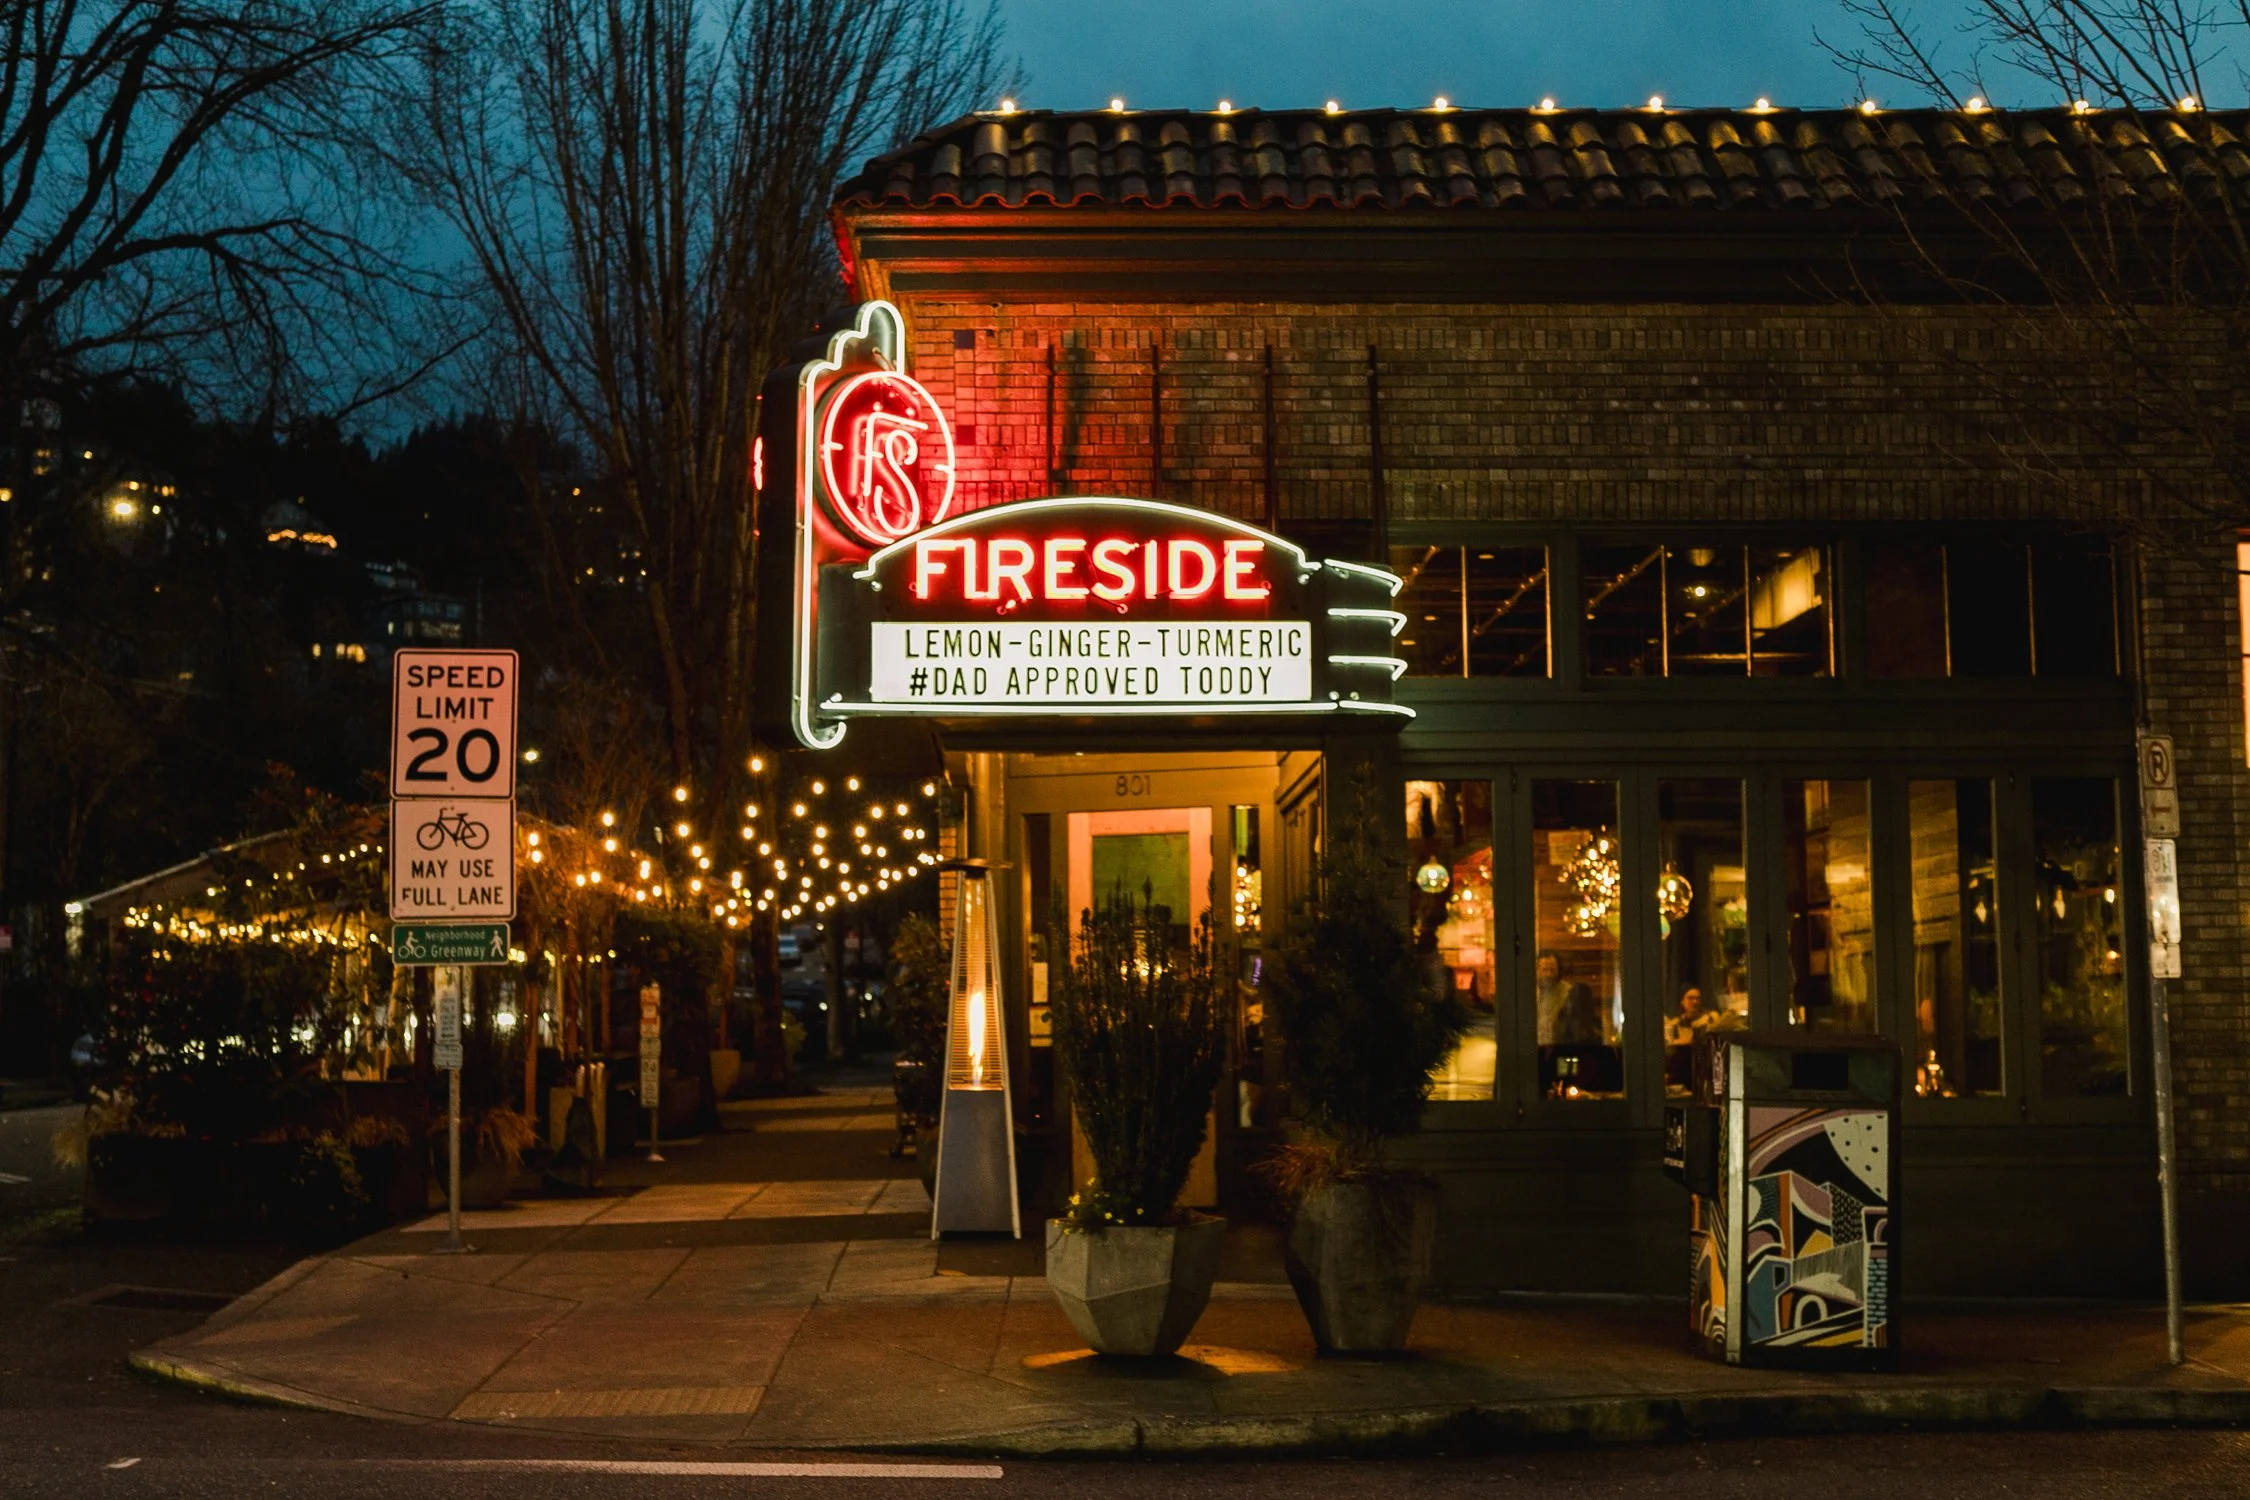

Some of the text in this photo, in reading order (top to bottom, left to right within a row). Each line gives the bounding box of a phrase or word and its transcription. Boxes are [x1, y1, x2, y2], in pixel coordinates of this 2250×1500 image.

[914, 538, 1272, 602] FIRESIDE
[904, 628, 1303, 659] LEMON-GINGER-TURMERIC
[406, 664, 505, 689] SPEED
[908, 666, 1273, 696] #DAD APPROVED TODDY
[416, 696, 495, 720] LIMIT
[404, 726, 500, 784] 20
[1114, 774, 1152, 798] 801
[410, 859, 495, 879] MAY USE
[401, 886, 504, 906] FULL LANE
[424, 929, 486, 942] Neighborhood
[430, 943, 486, 960] Greenway
